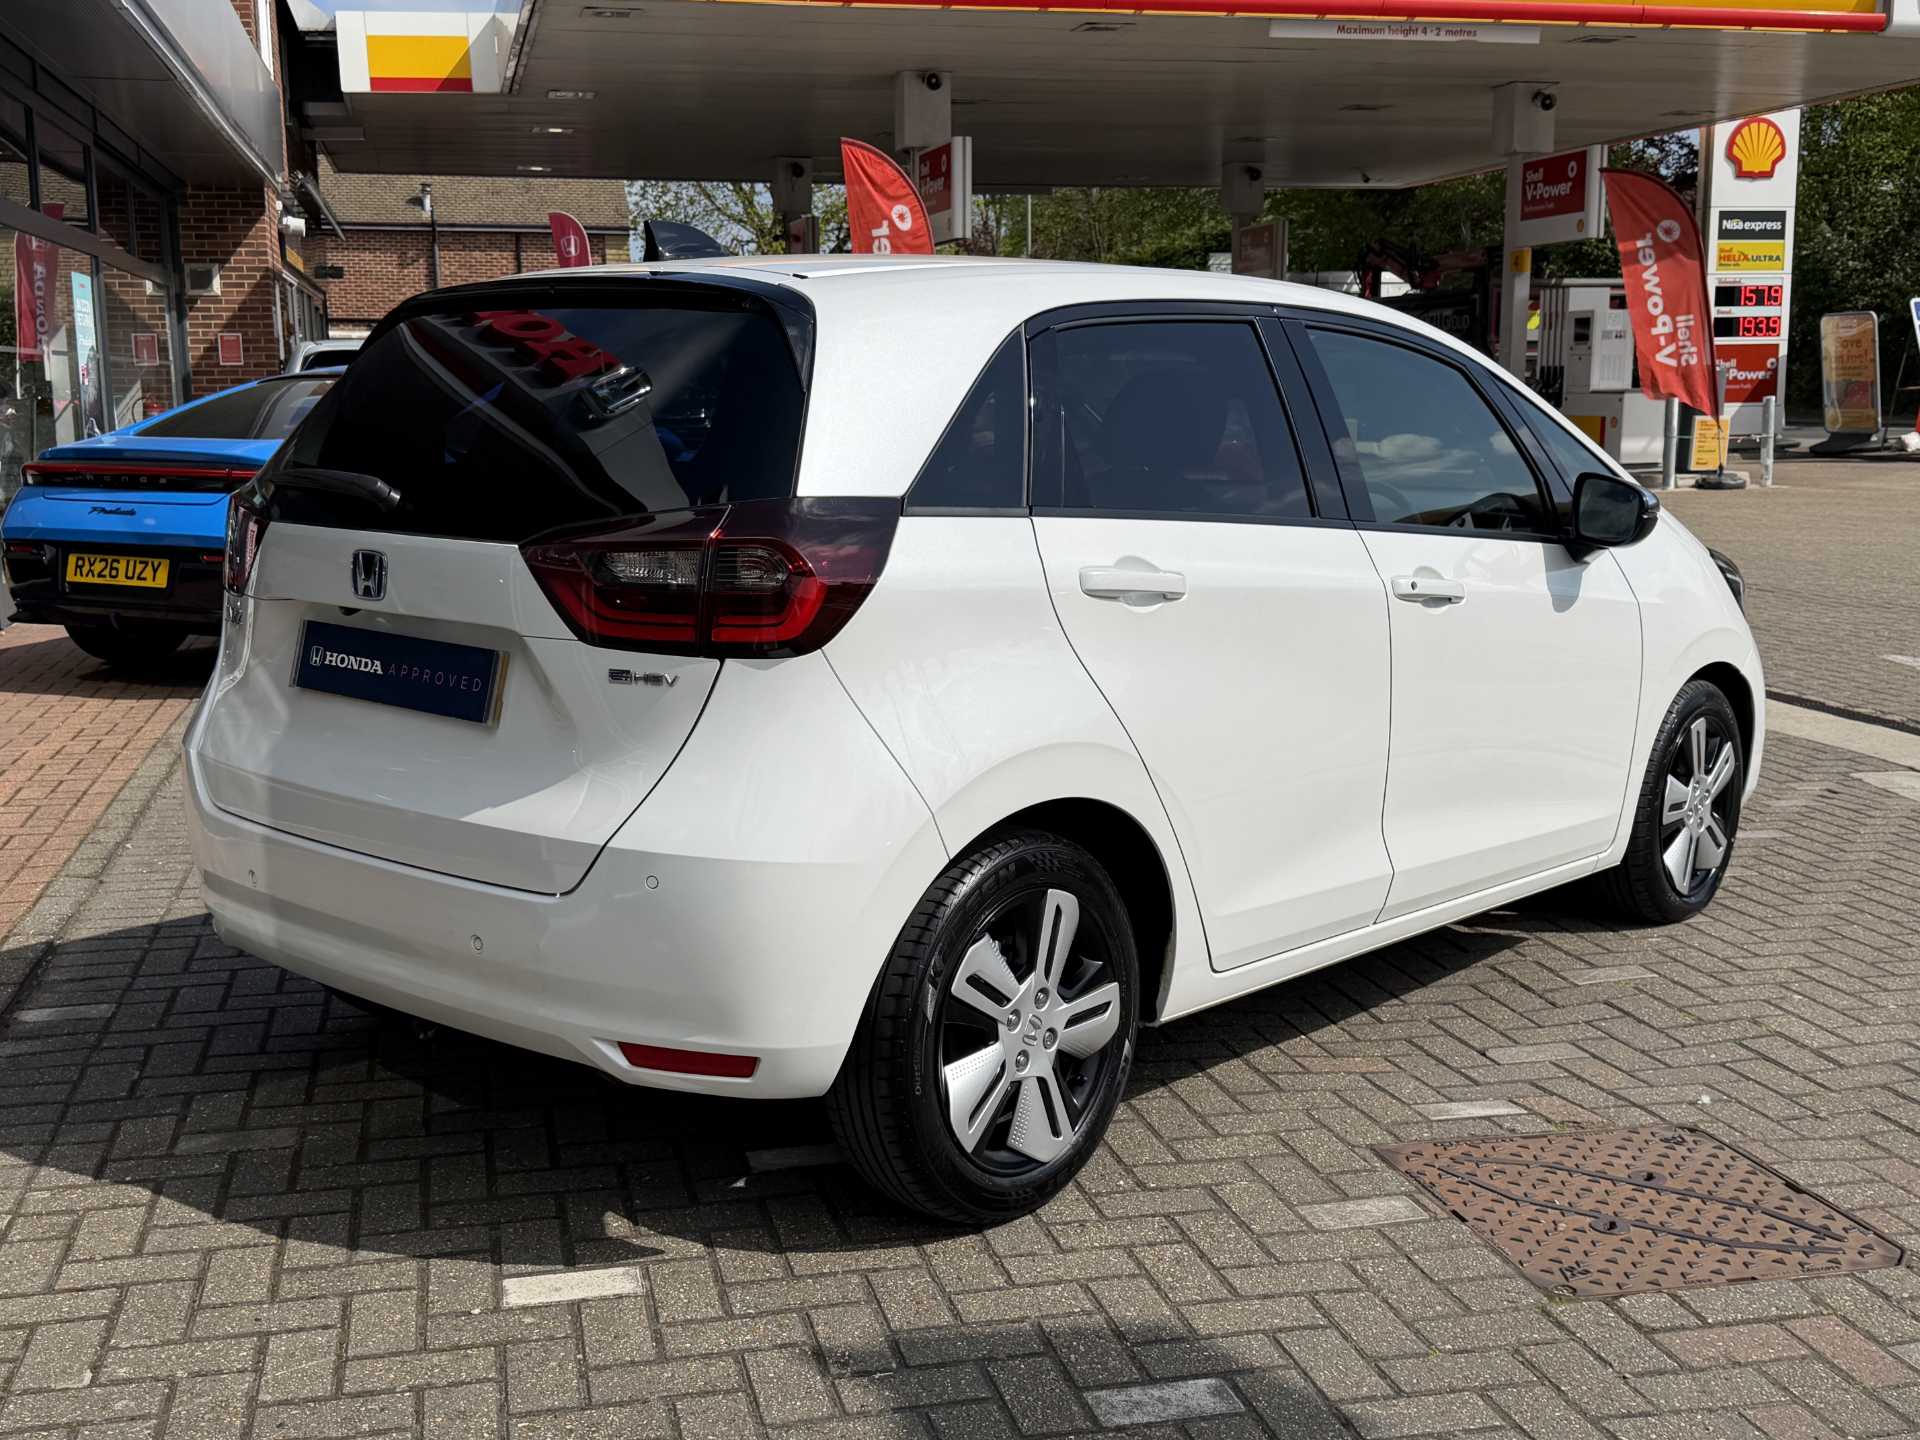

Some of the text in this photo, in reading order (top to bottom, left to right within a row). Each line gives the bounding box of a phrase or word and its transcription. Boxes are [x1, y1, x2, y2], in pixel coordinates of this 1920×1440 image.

[1336, 24, 1387, 36] Maximum
[1387, 26, 1419, 38] height
[1444, 28, 1478, 38] metres
[1751, 254, 1782, 263] ULTRA
[1741, 286, 1782, 306] 157.9
[1739, 317, 1780, 337] 193.9
[73, 557, 163, 583] RX26 UZY
[324, 651, 483, 693] HONDA APPROVED
